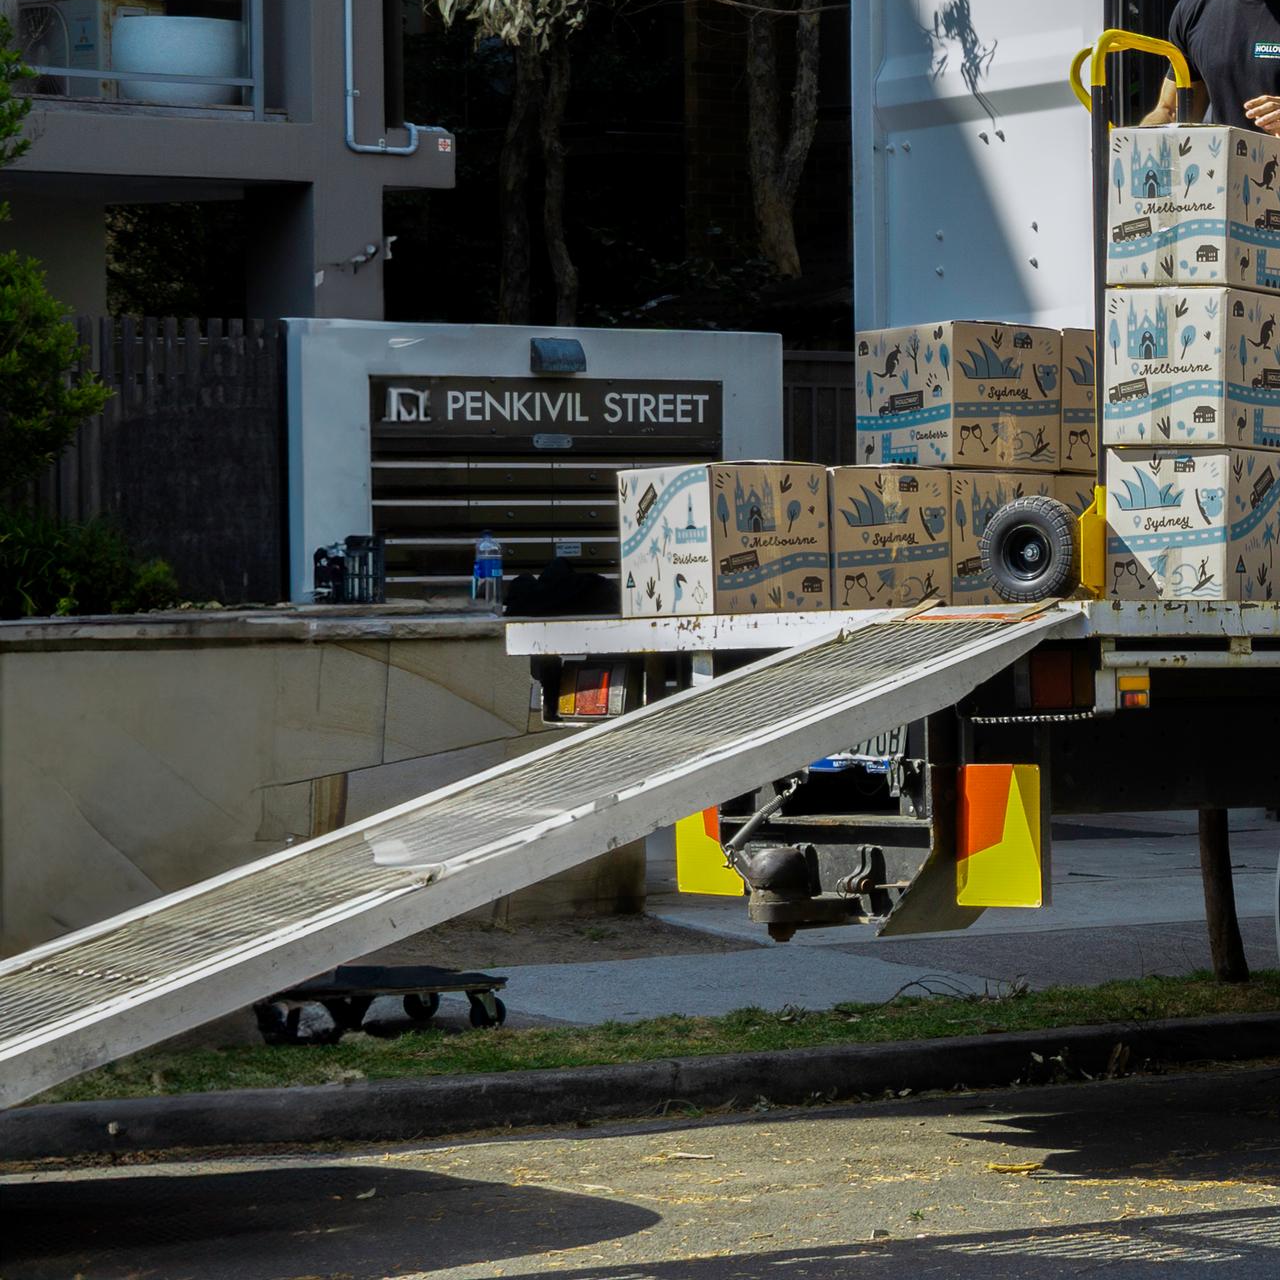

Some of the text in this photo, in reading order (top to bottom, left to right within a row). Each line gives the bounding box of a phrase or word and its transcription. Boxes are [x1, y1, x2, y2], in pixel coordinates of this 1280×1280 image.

[1143, 201, 1215, 215] Melbourne
[1139, 362, 1213, 376] Melbourne
[987, 385, 1032, 401] Sydney
[447, 390, 590, 422] PENKIVIL
[603, 392, 710, 423] STREET
[1144, 515, 1194, 532] Sydney
[749, 536, 818, 549] Melbourne
[871, 532, 919, 546] Sydney
[671, 552, 709, 565] Brisbane
